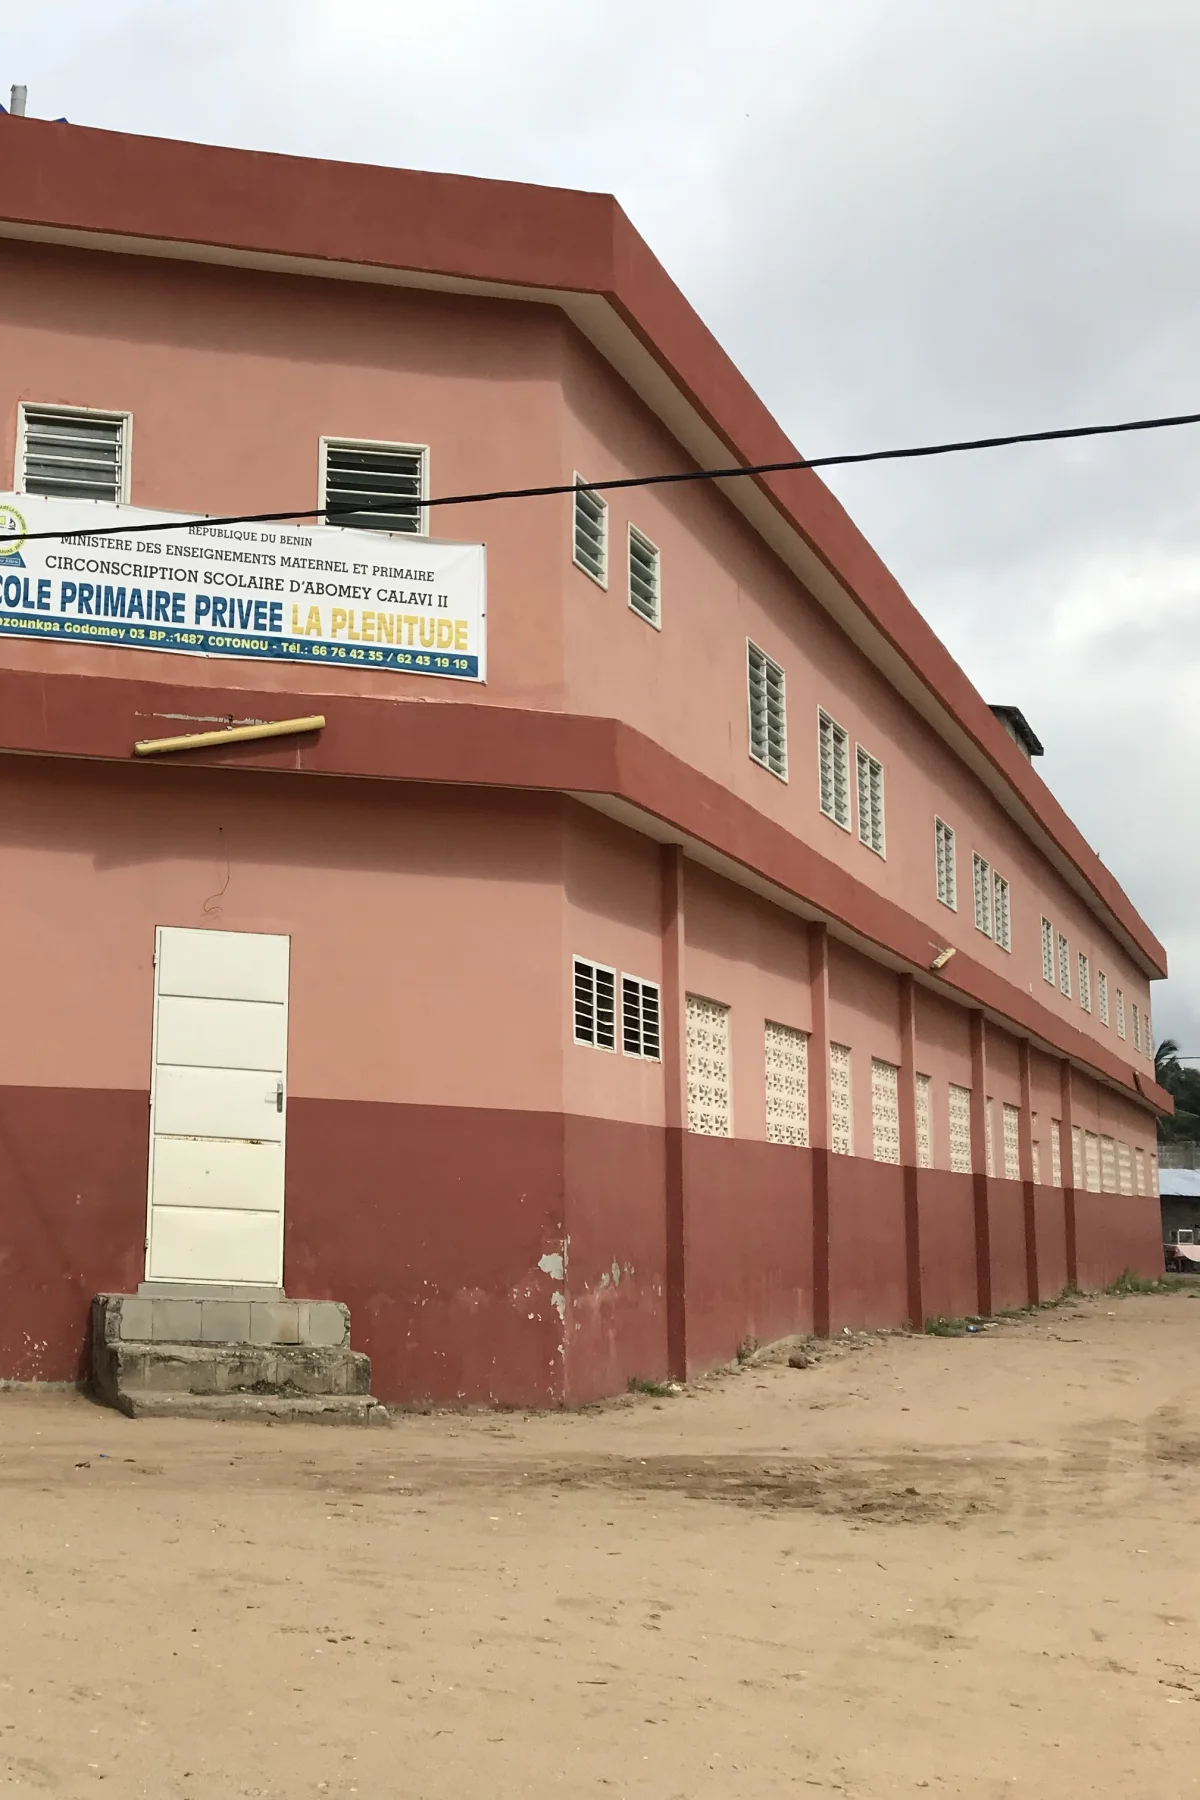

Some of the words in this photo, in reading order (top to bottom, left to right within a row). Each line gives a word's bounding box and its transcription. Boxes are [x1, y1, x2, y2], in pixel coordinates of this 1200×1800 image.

[60, 534, 132, 552] MINISTERE
[136, 542, 162, 554] DES
[166, 544, 276, 566] ENSEIGNEMENTS
[280, 555, 349, 573] MATERNEL
[352, 563, 369, 575] ET
[372, 566, 435, 582] PRIMAIRE
[188, 525, 257, 542] REPUBLIQUE
[260, 534, 276, 544] DU
[280, 535, 313, 547] BENIN
[45, 555, 198, 583] CIRCONSCRIPTION
[203, 571, 285, 591] SCOLAIRE
[290, 580, 372, 600] D'ABOMEY
[376, 589, 433, 607] CALAVI
[437, 595, 448, 608] II
[60, 581, 186, 624] PRIMAIRE
[195, 594, 283, 633] PRIVEE
[291, 603, 322, 637] LA
[331, 608, 468, 650] PLENITUDE
[64, 621, 126, 639] Godomey
[208, 636, 269, 651] COTONOU
[312, 645, 327, 656] 66
[331, 646, 346, 658] 76
[349, 648, 364, 660] 42
[368, 650, 384, 662] 35
[386, 652, 393, 663] /
[396, 653, 412, 665] 62
[415, 655, 431, 667] 43
[435, 657, 450, 668] 19
[453, 659, 469, 670] 19
